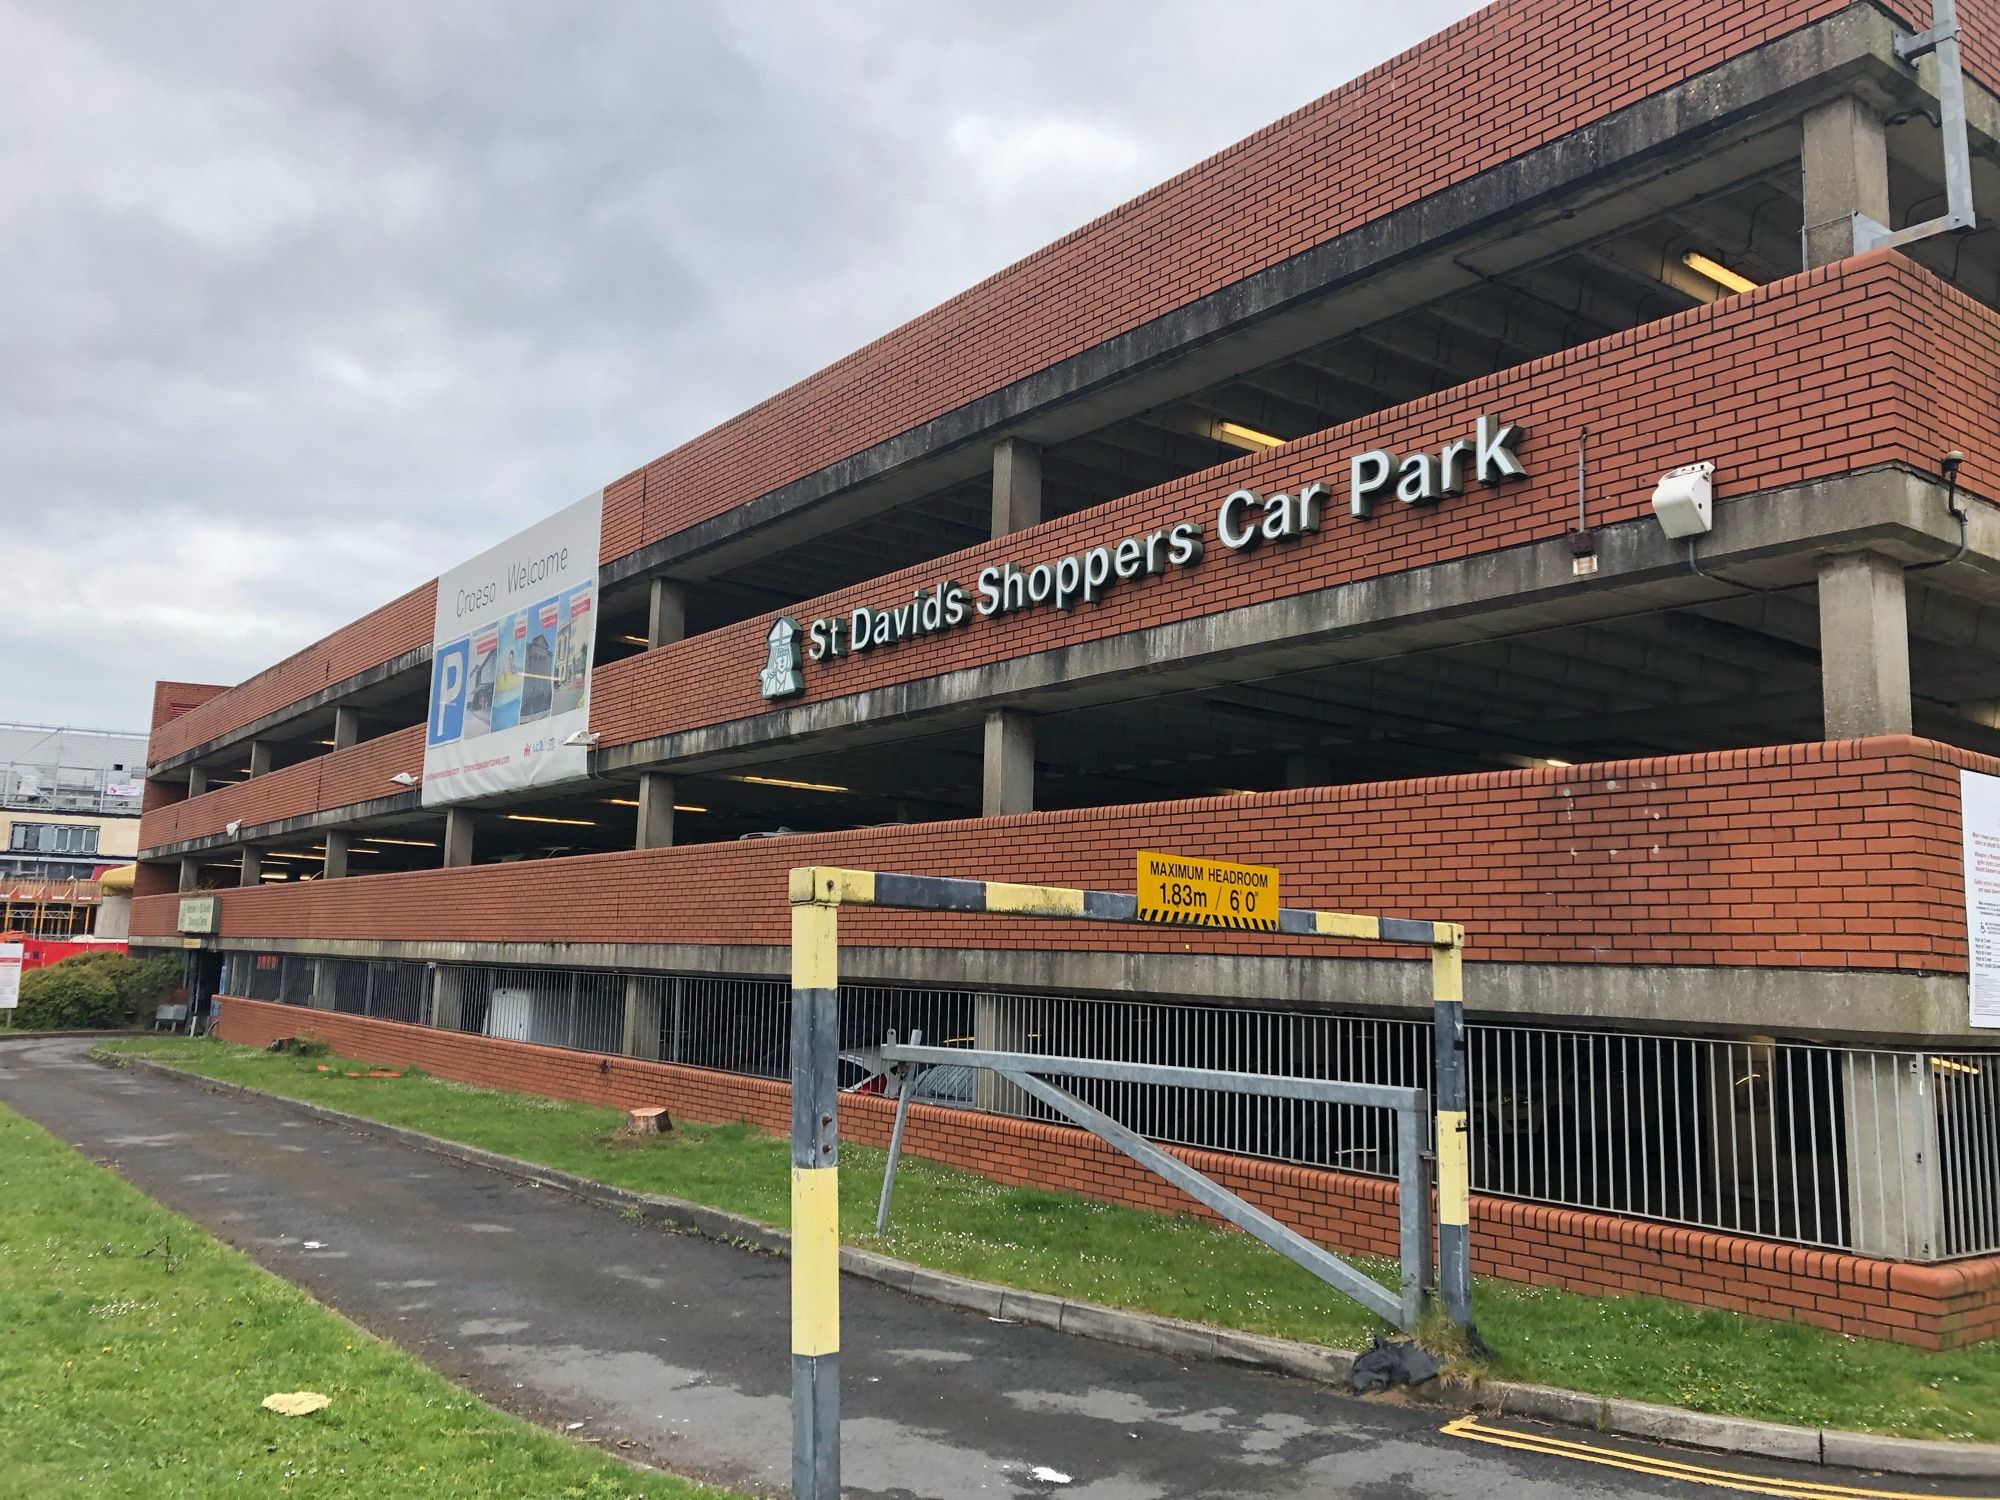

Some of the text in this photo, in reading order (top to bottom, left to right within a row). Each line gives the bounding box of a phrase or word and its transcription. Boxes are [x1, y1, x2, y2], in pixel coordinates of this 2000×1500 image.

[808, 414, 1526, 661] St David's Shoppers Car Park
[456, 582, 496, 618] Croeso
[507, 547, 568, 595] Welcome
[437, 651, 463, 737] P
[1150, 860, 1268, 888] MAXIMUM HEADROOM
[1160, 882, 1207, 908] 1.83m
